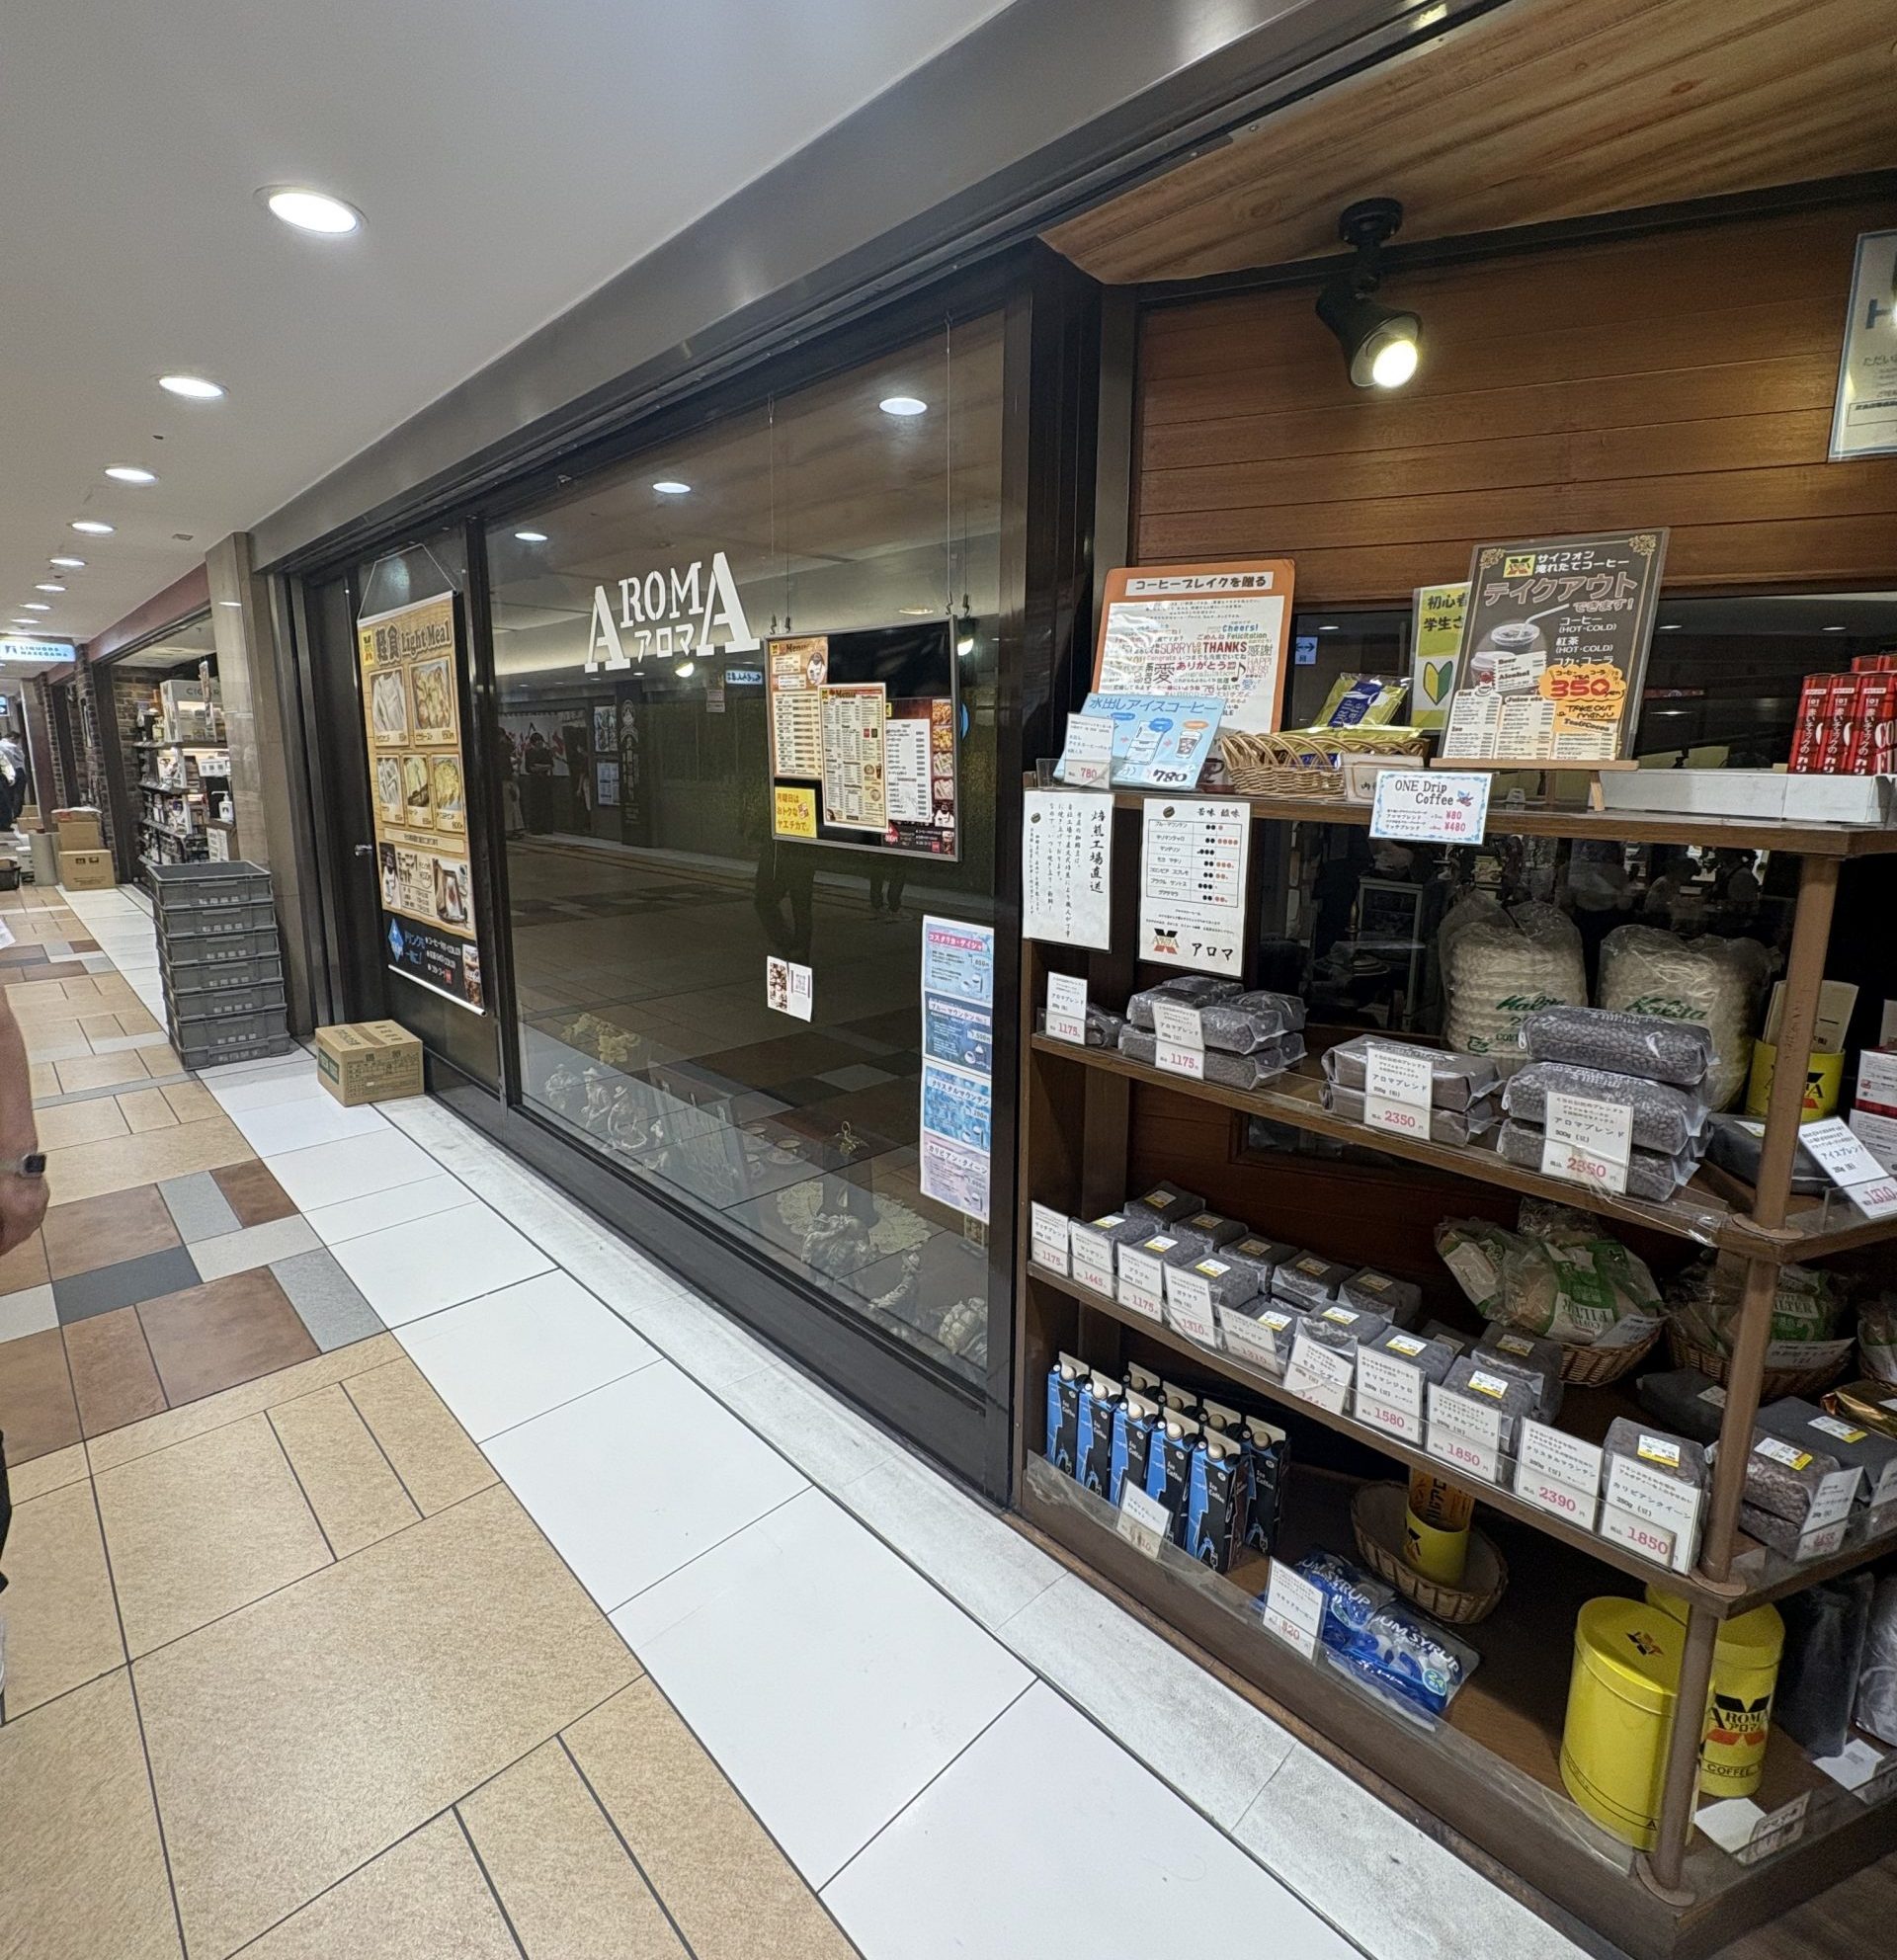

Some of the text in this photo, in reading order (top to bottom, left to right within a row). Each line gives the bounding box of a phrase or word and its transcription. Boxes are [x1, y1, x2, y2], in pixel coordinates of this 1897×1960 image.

[1534, 558, 1630, 574] 淹れたてコーヒー
[1537, 550, 1595, 564] サイフォン
[1135, 575, 1267, 591] コーヒーブレイクを贈る
[1484, 571, 1638, 607] テイクアウト
[585, 552, 760, 673] AROMA
[1559, 616, 1603, 626] コーヒー
[1222, 623, 1259, 632] Cheers!
[634, 623, 695, 663] アロマ
[1160, 642, 1193, 655] SORRY
[1203, 641, 1248, 653] THANKS
[1248, 644, 1273, 656] 感謝
[1556, 636, 1580, 646] 紅茶
[1153, 663, 1176, 684] 愛
[1176, 661, 1227, 671] ありがとう
[1550, 679, 1610, 697] 350
[1089, 697, 1218, 714] 水出しアイスコーヒー
[1081, 768, 1097, 777] 780
[1153, 769, 1188, 782] 780
[1394, 779, 1447, 794] ONE Drip
[1415, 792, 1454, 805] Coffee
[1090, 809, 1106, 894] 焙煎工場直送
[1191, 942, 1234, 961] アロマ
[1058, 1022, 1079, 1037] 1175
[1170, 1053, 1195, 1069] 1175
[1372, 1074, 1428, 1092] アロマブレンド
[1384, 1109, 1416, 1128] 2350
[1554, 1116, 1625, 1138] アロマブレンド
[1567, 1157, 1607, 1178] 2350
[1132, 1294, 1154, 1312] 1175
[1374, 1407, 1405, 1428] 1580
[1446, 1442, 1480, 1466] 1850
[1526, 1445, 1596, 1478] クリスタルマウンテン
[1538, 1486, 1576, 1511] 2390
[1627, 1525, 1668, 1555] 1850
[1407, 1633, 1461, 1674] SYRUP
